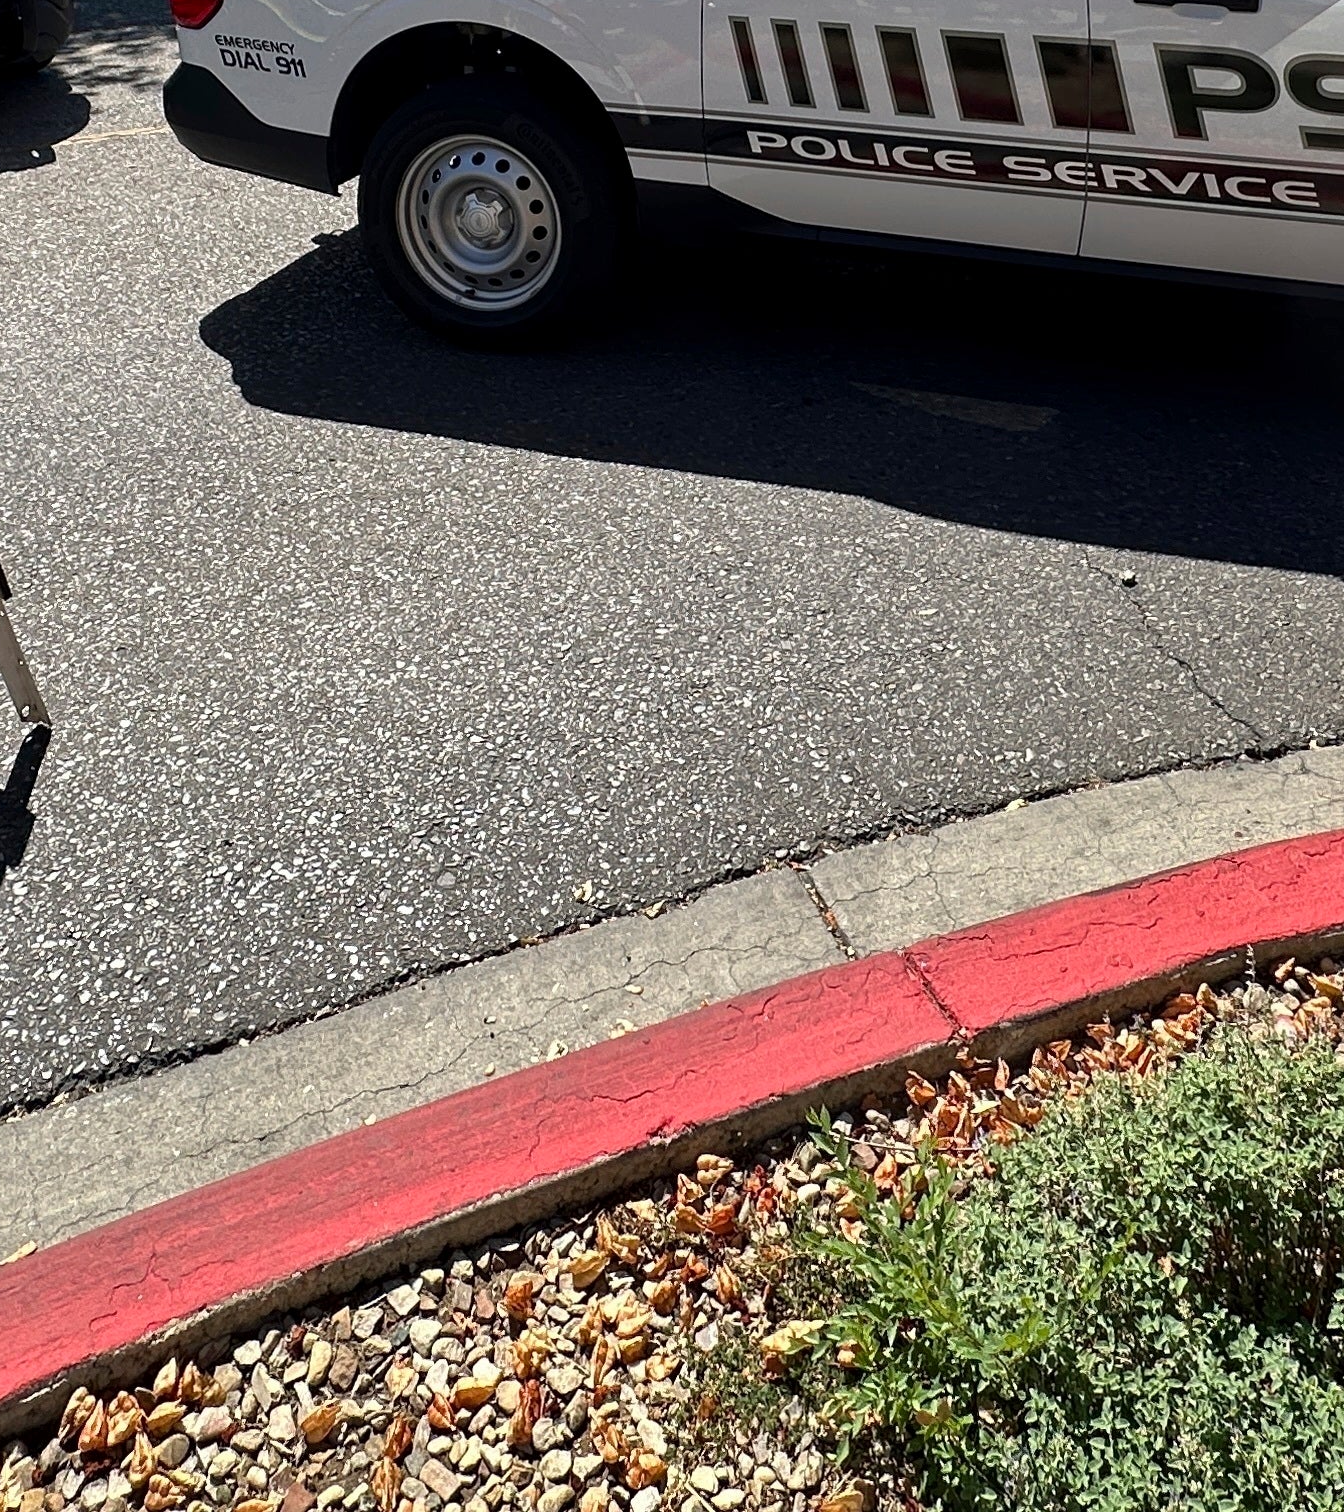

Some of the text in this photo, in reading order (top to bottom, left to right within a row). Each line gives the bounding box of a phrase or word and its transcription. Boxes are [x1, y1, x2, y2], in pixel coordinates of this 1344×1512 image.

[215, 34, 295, 55] EMERGENCY
[219, 47, 307, 78] DIAL 911
[746, 130, 976, 176] POLICE
[1002, 155, 1320, 208] SERVICE
